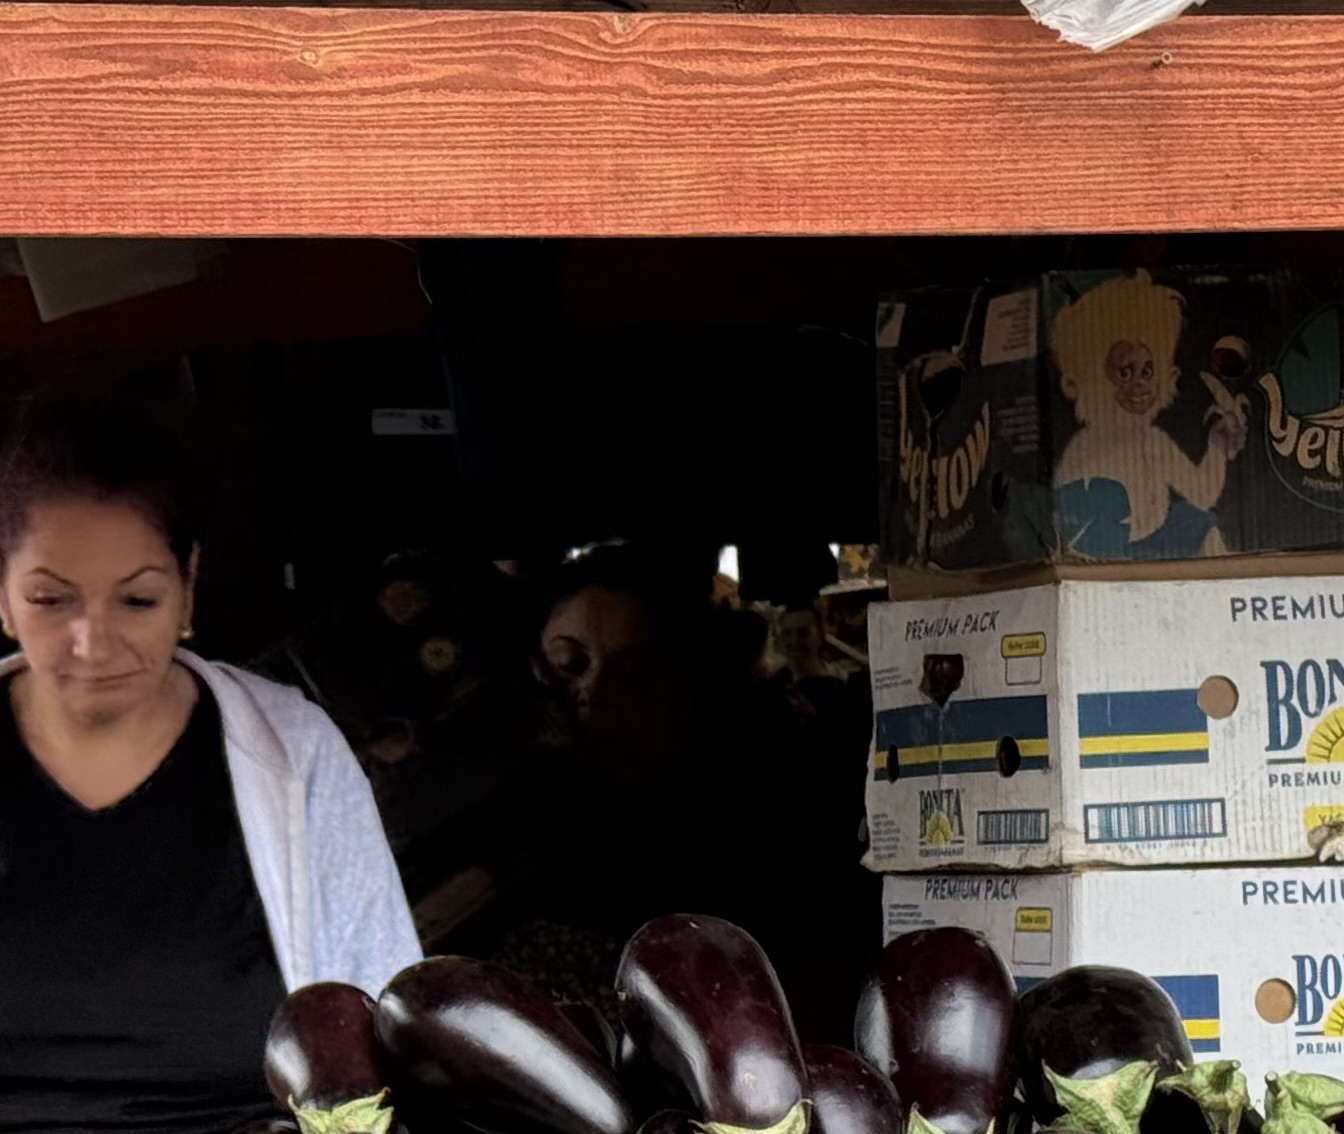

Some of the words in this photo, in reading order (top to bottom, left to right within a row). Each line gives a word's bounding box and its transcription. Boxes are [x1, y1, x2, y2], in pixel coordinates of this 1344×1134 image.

[905, 617, 960, 642] PREMIUM
[961, 610, 1000, 635] PACK
[925, 879, 981, 900] PREMIUM
[983, 878, 1019, 900] PACK
